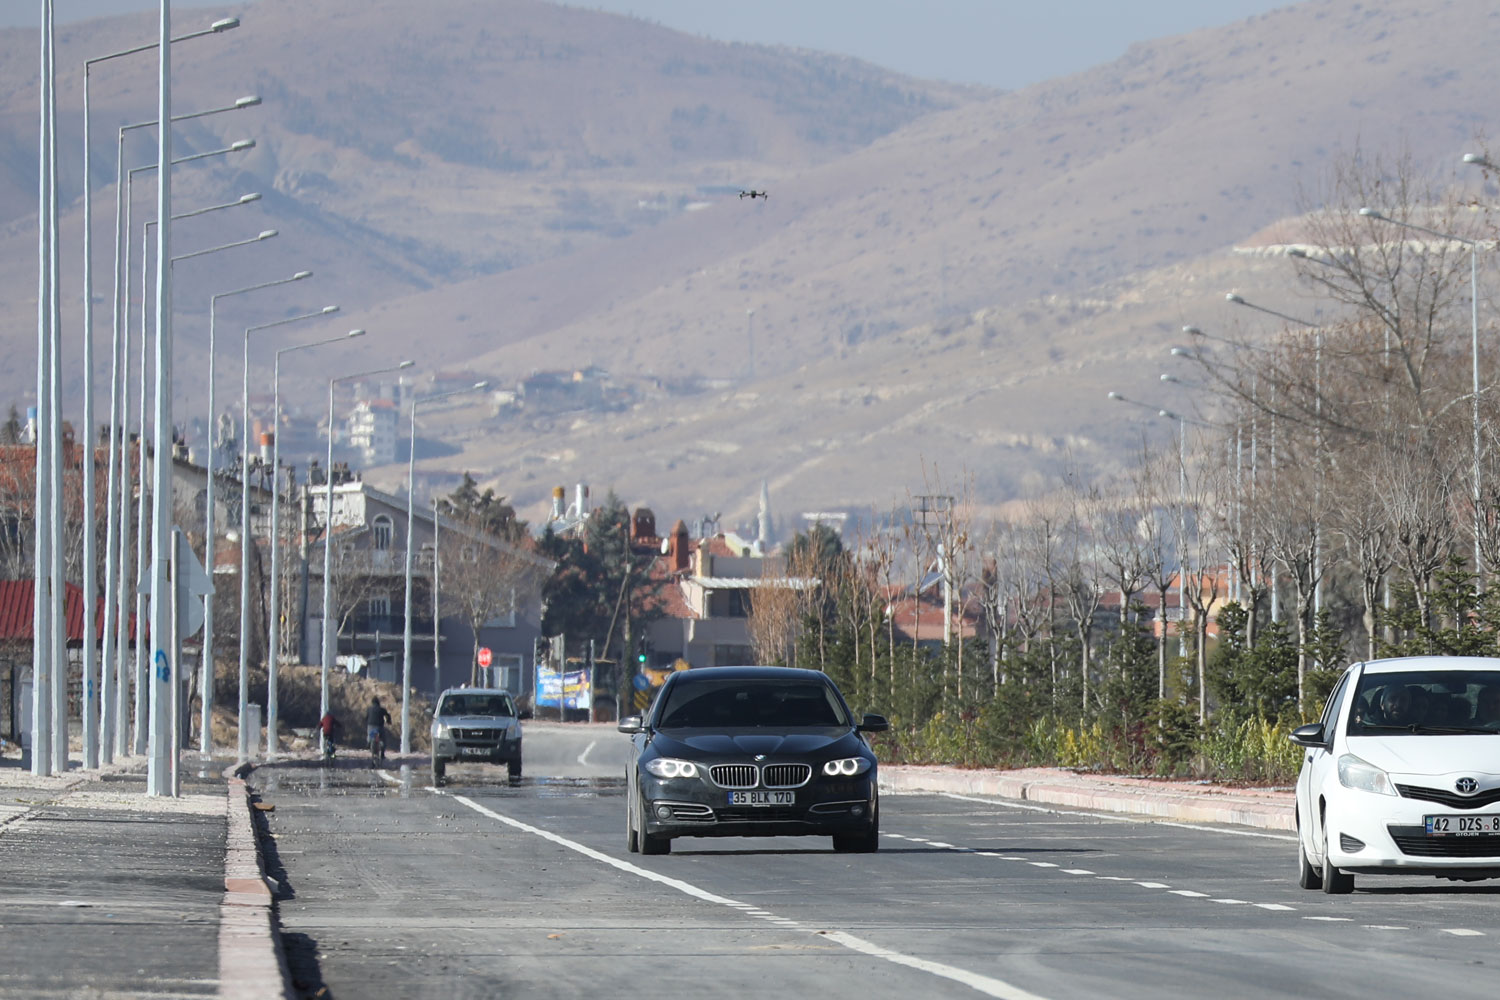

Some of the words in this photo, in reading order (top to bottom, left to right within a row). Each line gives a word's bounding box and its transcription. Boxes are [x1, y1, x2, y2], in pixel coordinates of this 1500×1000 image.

[734, 792, 746, 803] 35
[751, 792, 770, 803] BLK
[774, 792, 792, 803] 170
[1434, 818, 1449, 831] 42
[1460, 818, 1482, 831] DZS
